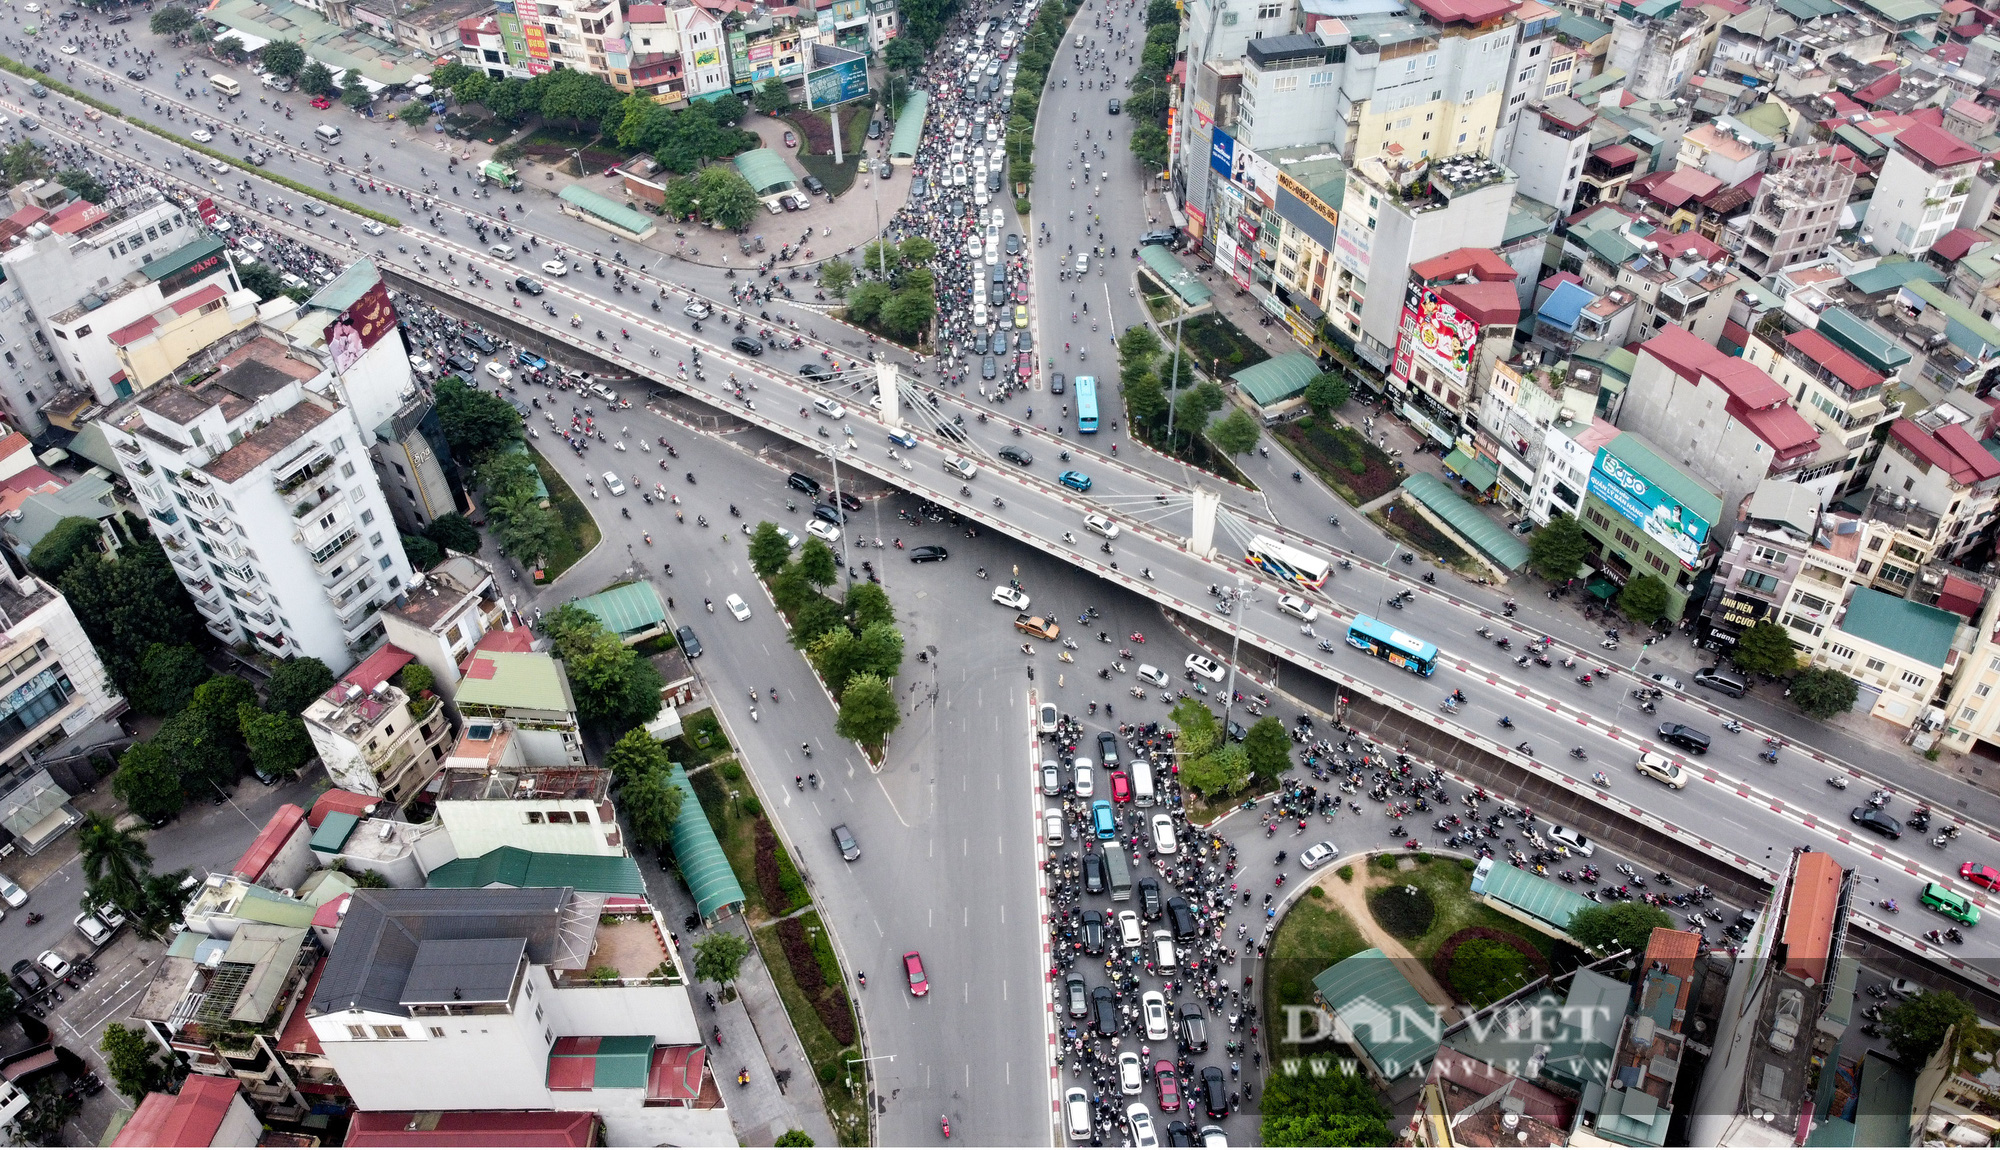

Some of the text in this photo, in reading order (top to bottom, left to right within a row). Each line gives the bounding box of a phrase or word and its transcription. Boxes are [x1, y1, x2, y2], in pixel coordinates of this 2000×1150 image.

[191, 255, 218, 274] VÀNG
[1424, 394, 1453, 419] TIGER SUGAR
[414, 447, 431, 464] Spa
[1602, 453, 1647, 496] Sapo
[1590, 475, 1608, 492] QUẢN
[1614, 492, 1627, 506] BÁN
[1626, 501, 1644, 518] HÀNG
[1600, 564, 1619, 582] XINH
[1720, 594, 1754, 615] ẢNH VIỆN
[1723, 609, 1757, 629] ÁO CƯỚI
